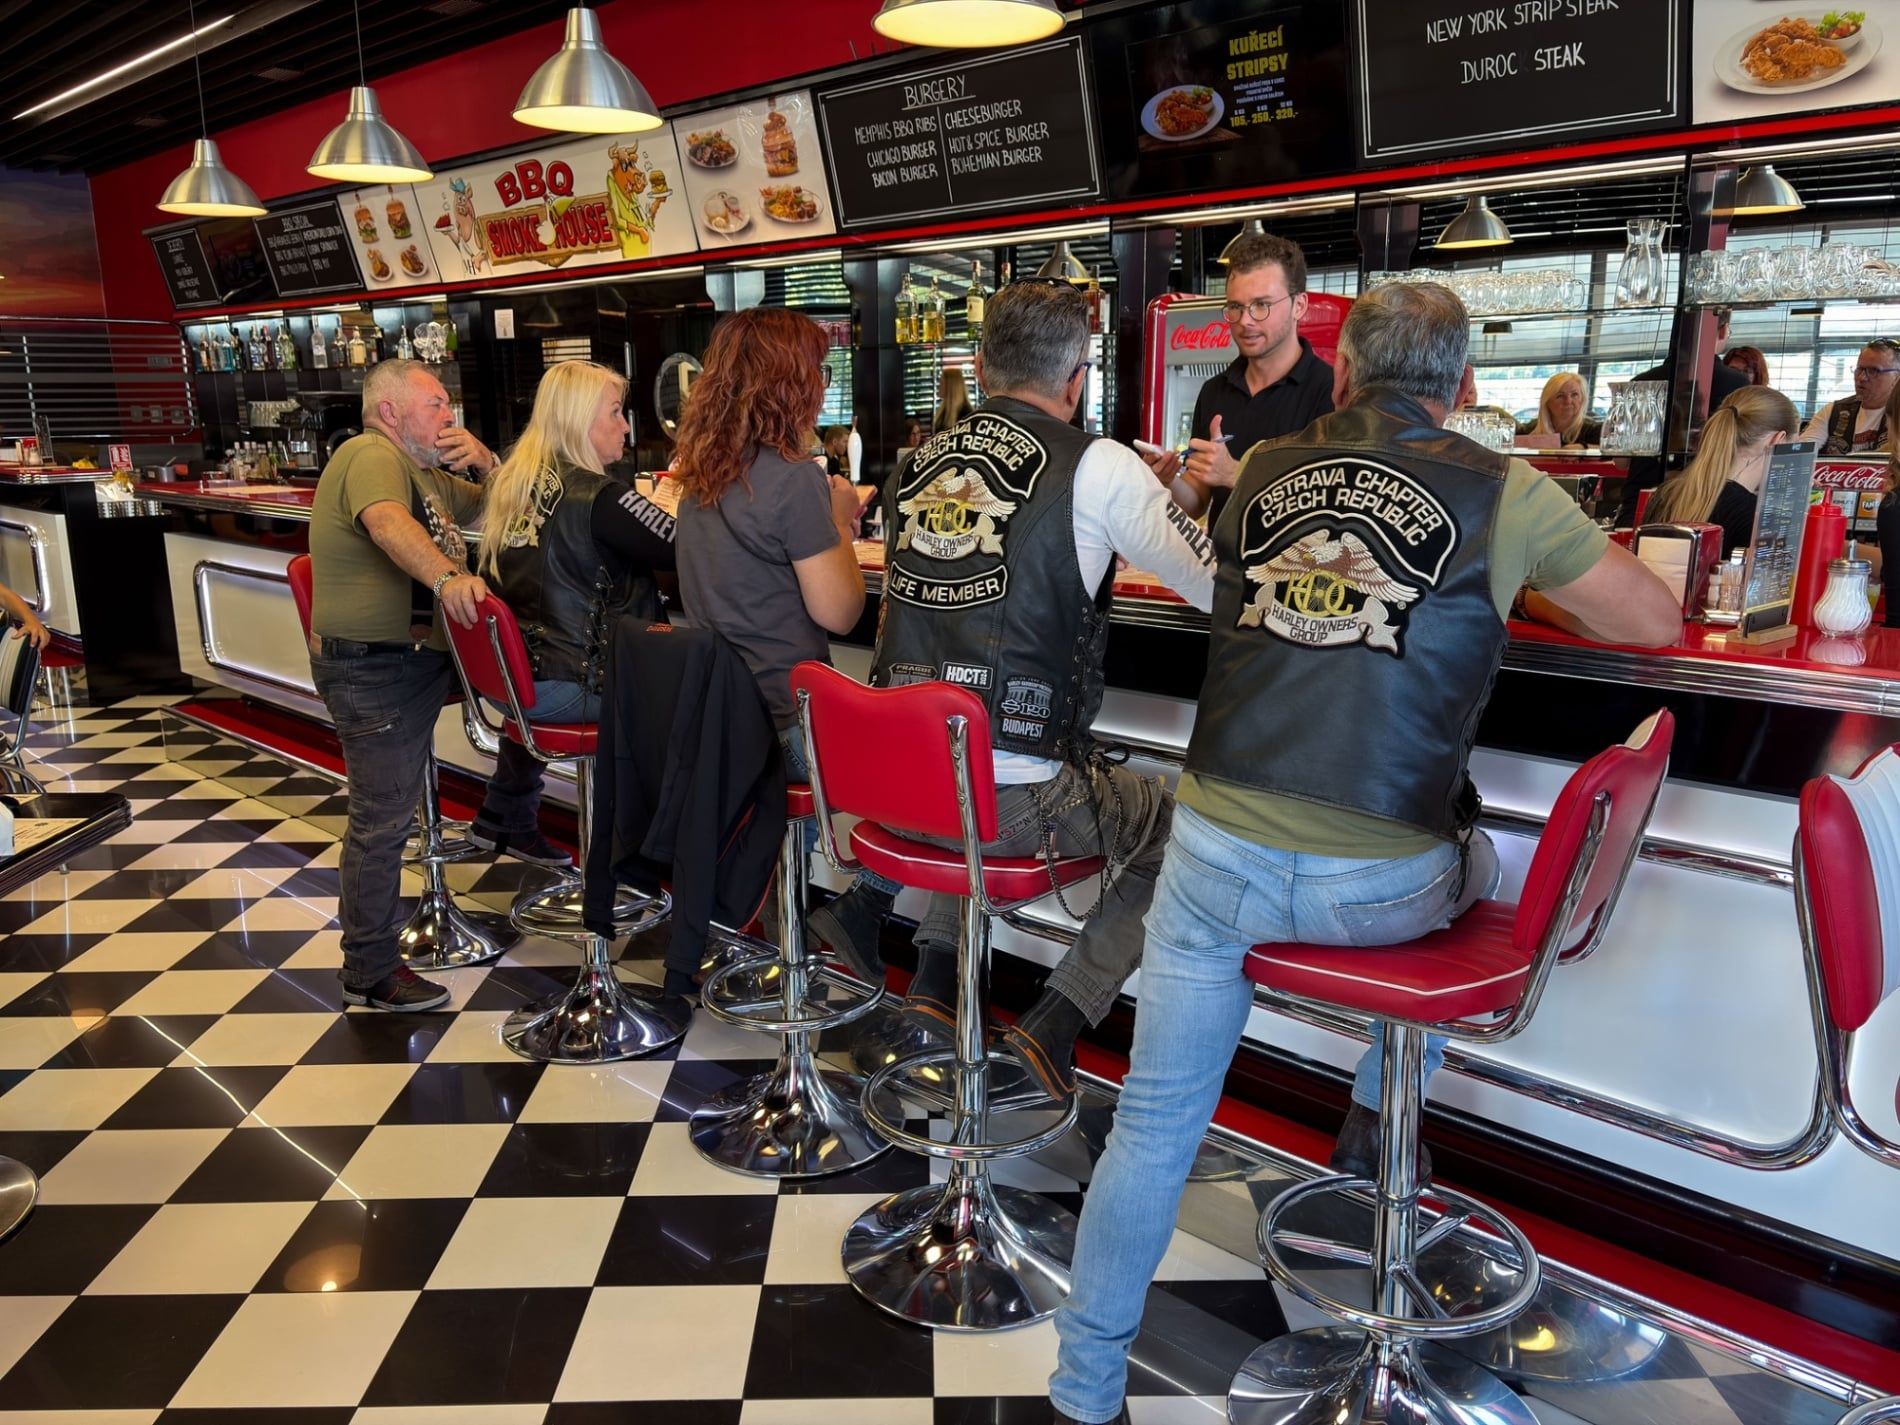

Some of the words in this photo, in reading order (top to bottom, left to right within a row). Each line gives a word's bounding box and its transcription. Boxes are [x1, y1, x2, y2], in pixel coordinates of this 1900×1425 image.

[1426, 16, 1463, 44] NEW
[1468, 7, 1508, 35] YORK
[1514, 0, 1563, 26] STRIP
[1228, 25, 1285, 56] KUŘECÍ
[1226, 53, 1289, 80] STRIPSY
[1460, 52, 1518, 84] DUROC
[1534, 42, 1585, 71] STEAK
[904, 74, 966, 108] BURGERY
[945, 99, 1023, 130] CHEESEBURGER
[855, 124, 892, 145] MEMPHIS
[893, 119, 914, 137] BBQ
[916, 116, 937, 133] RIBS
[1006, 122, 1050, 144] BURGER
[867, 146, 900, 168] CHICAGO
[901, 140, 937, 161] BURGER
[951, 152, 1000, 175] BOHEMIAN
[1003, 146, 1043, 167] BURGER
[494, 159, 574, 207] BBQ
[872, 171, 897, 188] BACON
[900, 163, 938, 182] BURGER
[486, 214, 548, 257] SMOKE
[913, 436, 957, 472] CZECH
[961, 434, 1023, 471] REPUBLIC
[976, 420, 1037, 459] CHAPTER
[1259, 467, 1346, 511] OSTRAVA
[1354, 469, 1443, 532] CHAPTER
[1260, 488, 1327, 529] CZECH
[1335, 488, 1428, 546] REPUBLIC
[916, 529, 943, 547] HARLEY
[943, 532, 974, 548] OWNERS
[930, 545, 958, 558] GROUP
[892, 572, 917, 597] LIFE
[922, 578, 1000, 602] MEMBER
[1271, 604, 1309, 629] HARLEY
[1309, 616, 1359, 633] OWNERS
[1289, 626, 1329, 643] GROUP
[945, 665, 981, 685] HDCT
[1020, 703, 1051, 718] 120
[1002, 718, 1044, 738] BUDAPEST
